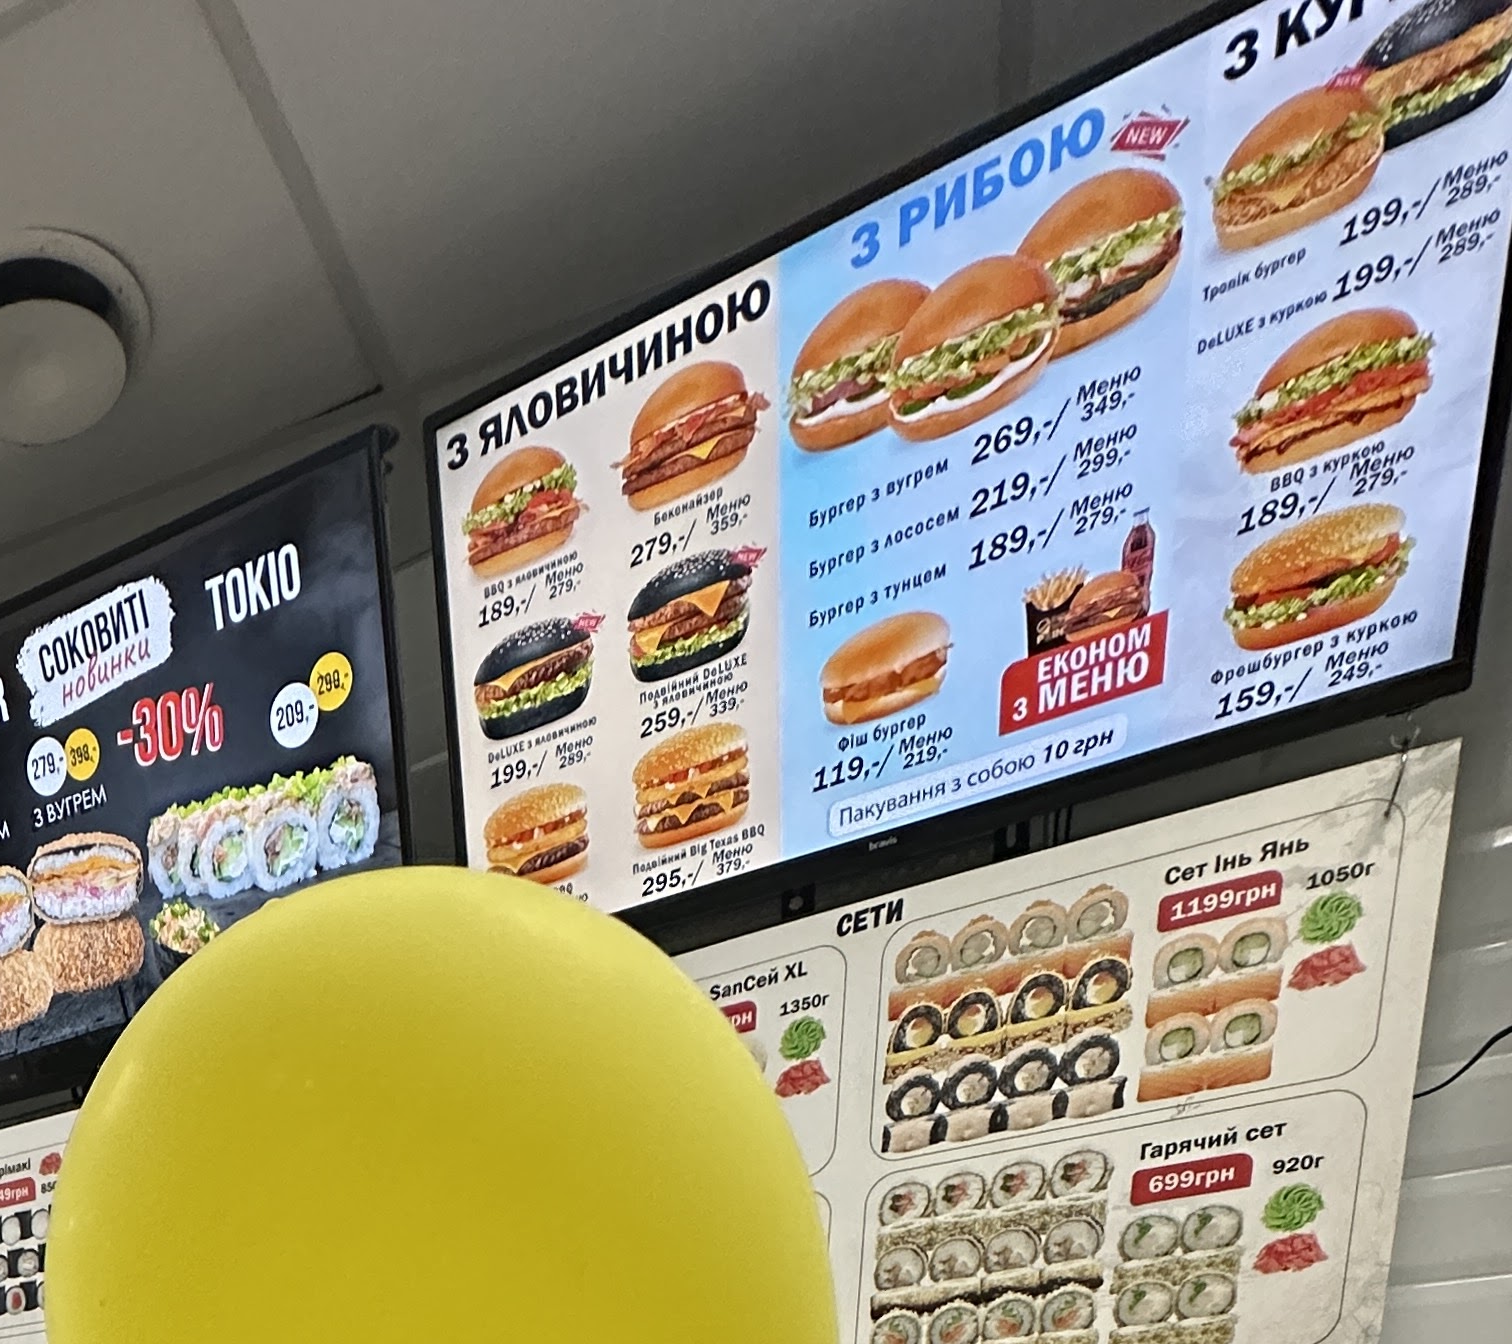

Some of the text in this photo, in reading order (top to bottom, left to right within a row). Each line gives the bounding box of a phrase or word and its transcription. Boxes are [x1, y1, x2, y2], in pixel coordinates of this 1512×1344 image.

[1125, 124, 1166, 145] NEW
[850, 108, 1105, 269] З РИБОЮ
[1442, 150, 1509, 190] Меню
[1254, 249, 1306, 281] бургер
[446, 279, 771, 471] З ЯЛОВИЧИНОЮ
[1076, 365, 1141, 405] Меню
[1073, 424, 1137, 462] Меню
[809, 492, 865, 528] Бургер
[887, 458, 949, 494] вугрем
[1069, 482, 1133, 520] Меню
[809, 543, 865, 578] Бургер
[884, 507, 959, 548] лососем
[205, 543, 302, 631] TOKIO
[809, 593, 865, 628] Бургер
[885, 565, 947, 599] тунцем
[39, 589, 150, 683] СОКОВИТІ
[1037, 621, 1151, 683] ЕКОНОМ
[1211, 639, 1324, 686] Фрешбургер
[1346, 610, 1418, 646] куркою
[1325, 640, 1389, 672] Меню
[62, 637, 151, 707] новинки
[1037, 651, 1149, 714] МЕНЮ
[117, 682, 224, 767] -30%
[838, 713, 926, 752] Фіш бургер
[898, 726, 953, 755] Меню
[839, 781, 946, 827] Пакування
[967, 753, 1035, 788] собою
[1044, 740, 1068, 763] 10
[1073, 729, 1114, 758] грн
[47, 785, 107, 824] ВУГРЕМ
[1165, 837, 1309, 885] Сет Інь Янь
[1306, 861, 1375, 890] 1050г
[836, 899, 905, 937] СЕТИ
[1170, 881, 1276, 922] 1199грн
[784, 961, 808, 982] XL
[779, 994, 830, 1016] 1350г
[1140, 1122, 1287, 1162] Гарячий сет
[1148, 1165, 1235, 1194] 699грн
[1272, 1154, 1324, 1175] 920г
